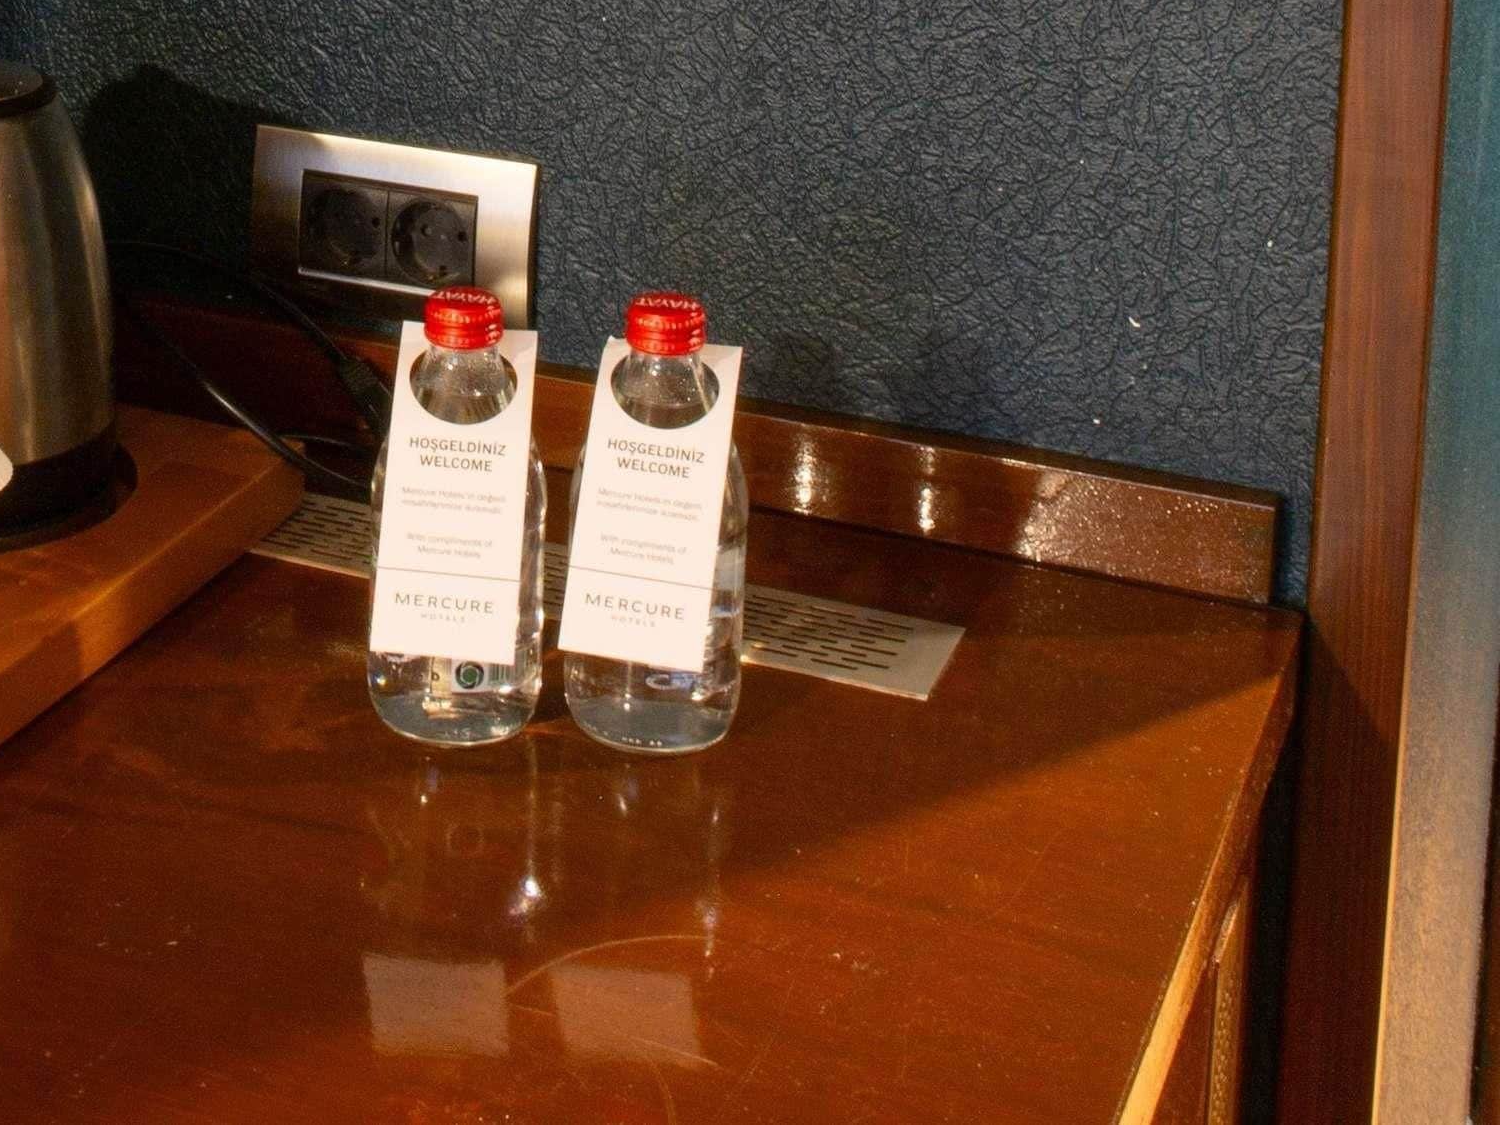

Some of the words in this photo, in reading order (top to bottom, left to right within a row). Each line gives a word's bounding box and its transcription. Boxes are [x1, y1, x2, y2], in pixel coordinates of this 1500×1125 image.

[409, 436, 507, 457] HOŞGELDİNİZ
[607, 438, 706, 464] HOŞGELDİNİZ
[419, 454, 493, 473] WELCOME
[616, 456, 691, 479] WELCOME
[394, 592, 495, 615] MERCURE
[584, 592, 686, 621] MERCURE
